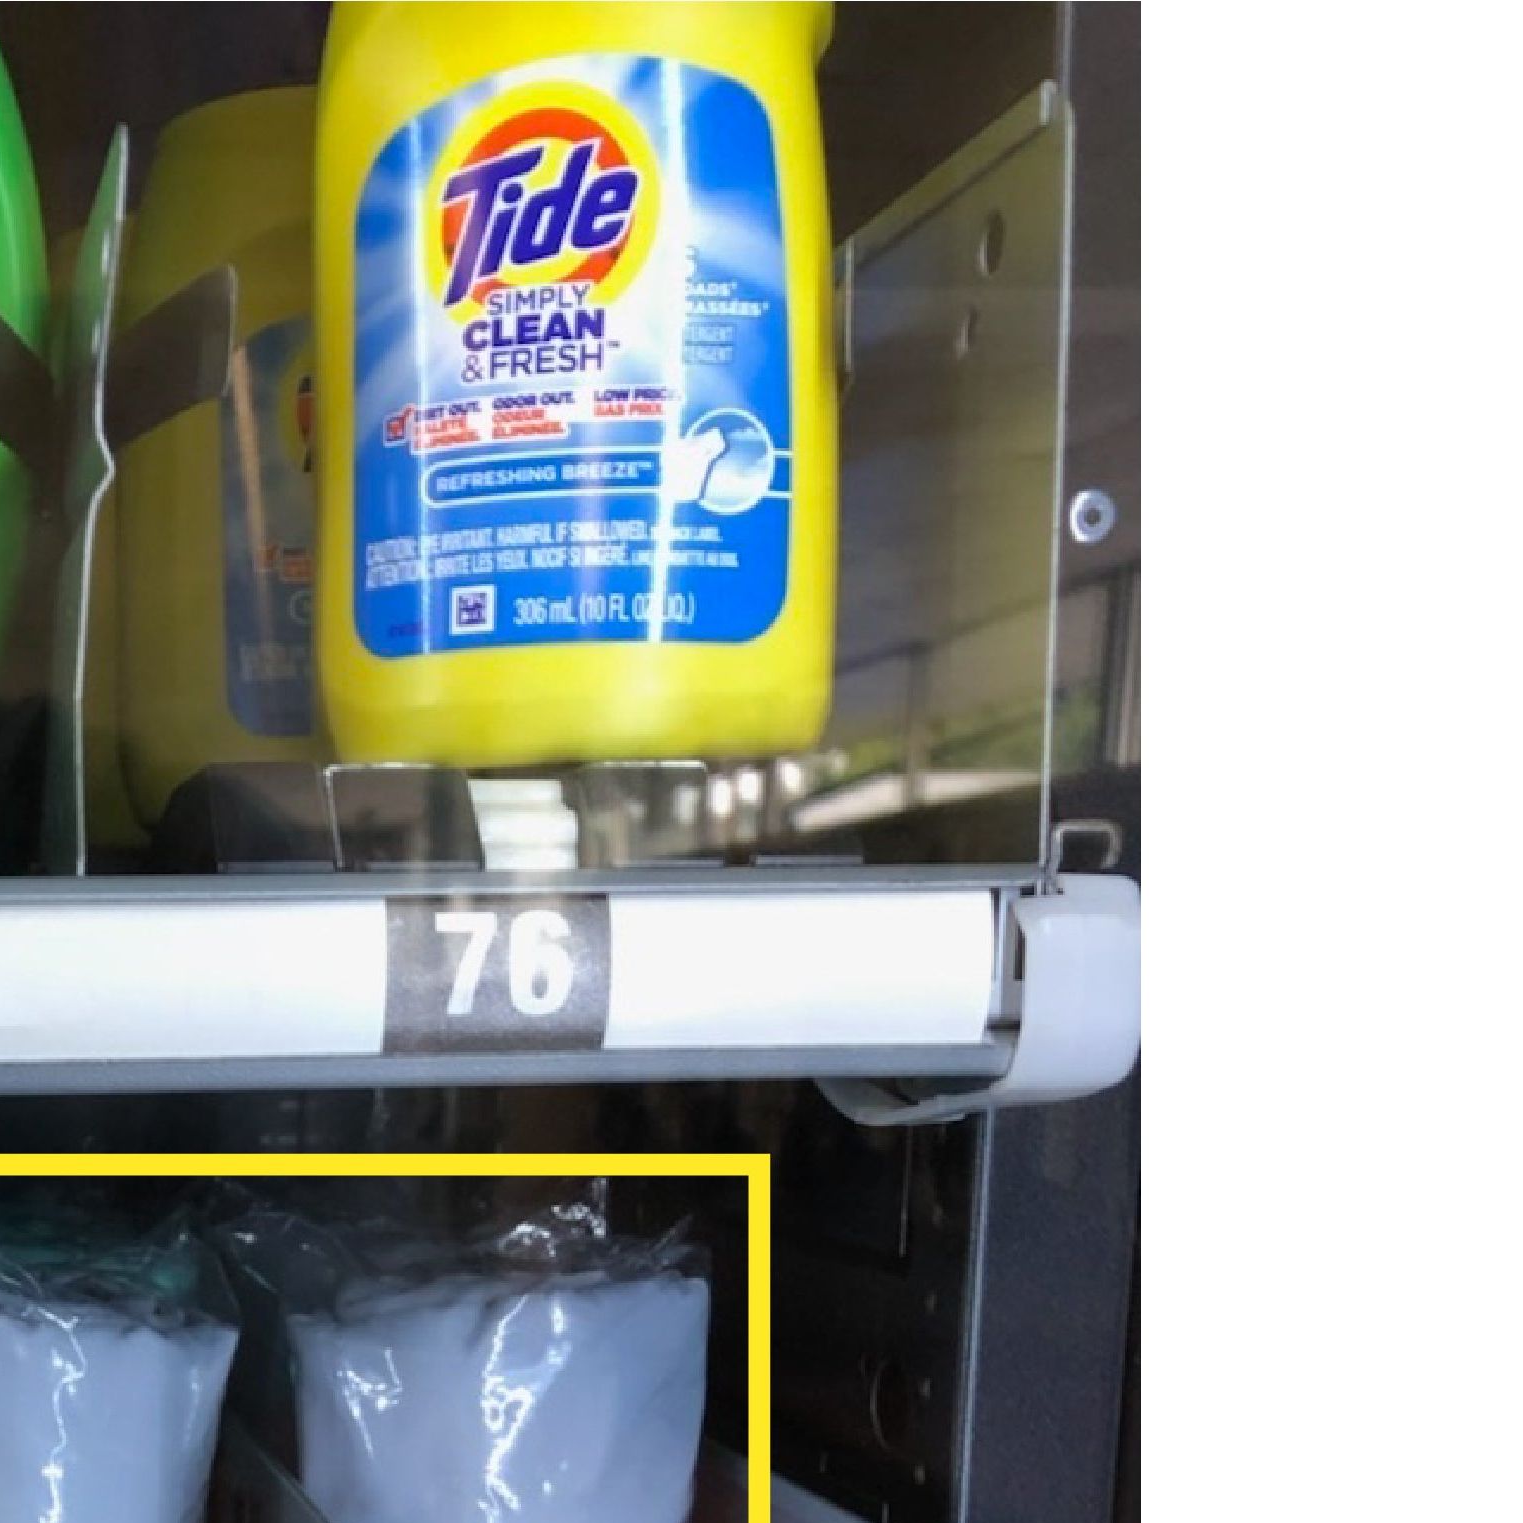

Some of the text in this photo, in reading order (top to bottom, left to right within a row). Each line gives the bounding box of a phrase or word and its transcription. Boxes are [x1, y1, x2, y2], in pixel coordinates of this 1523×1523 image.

[441, 136, 641, 309] Tide
[486, 283, 590, 317] SIMPLY
[461, 309, 606, 351] CLEAN
[462, 350, 485, 384] &
[593, 388, 631, 403] LOW
[436, 466, 557, 493] REFRESHING
[512, 597, 547, 626] 306
[548, 595, 574, 625] mL
[433, 909, 576, 1017] 76
